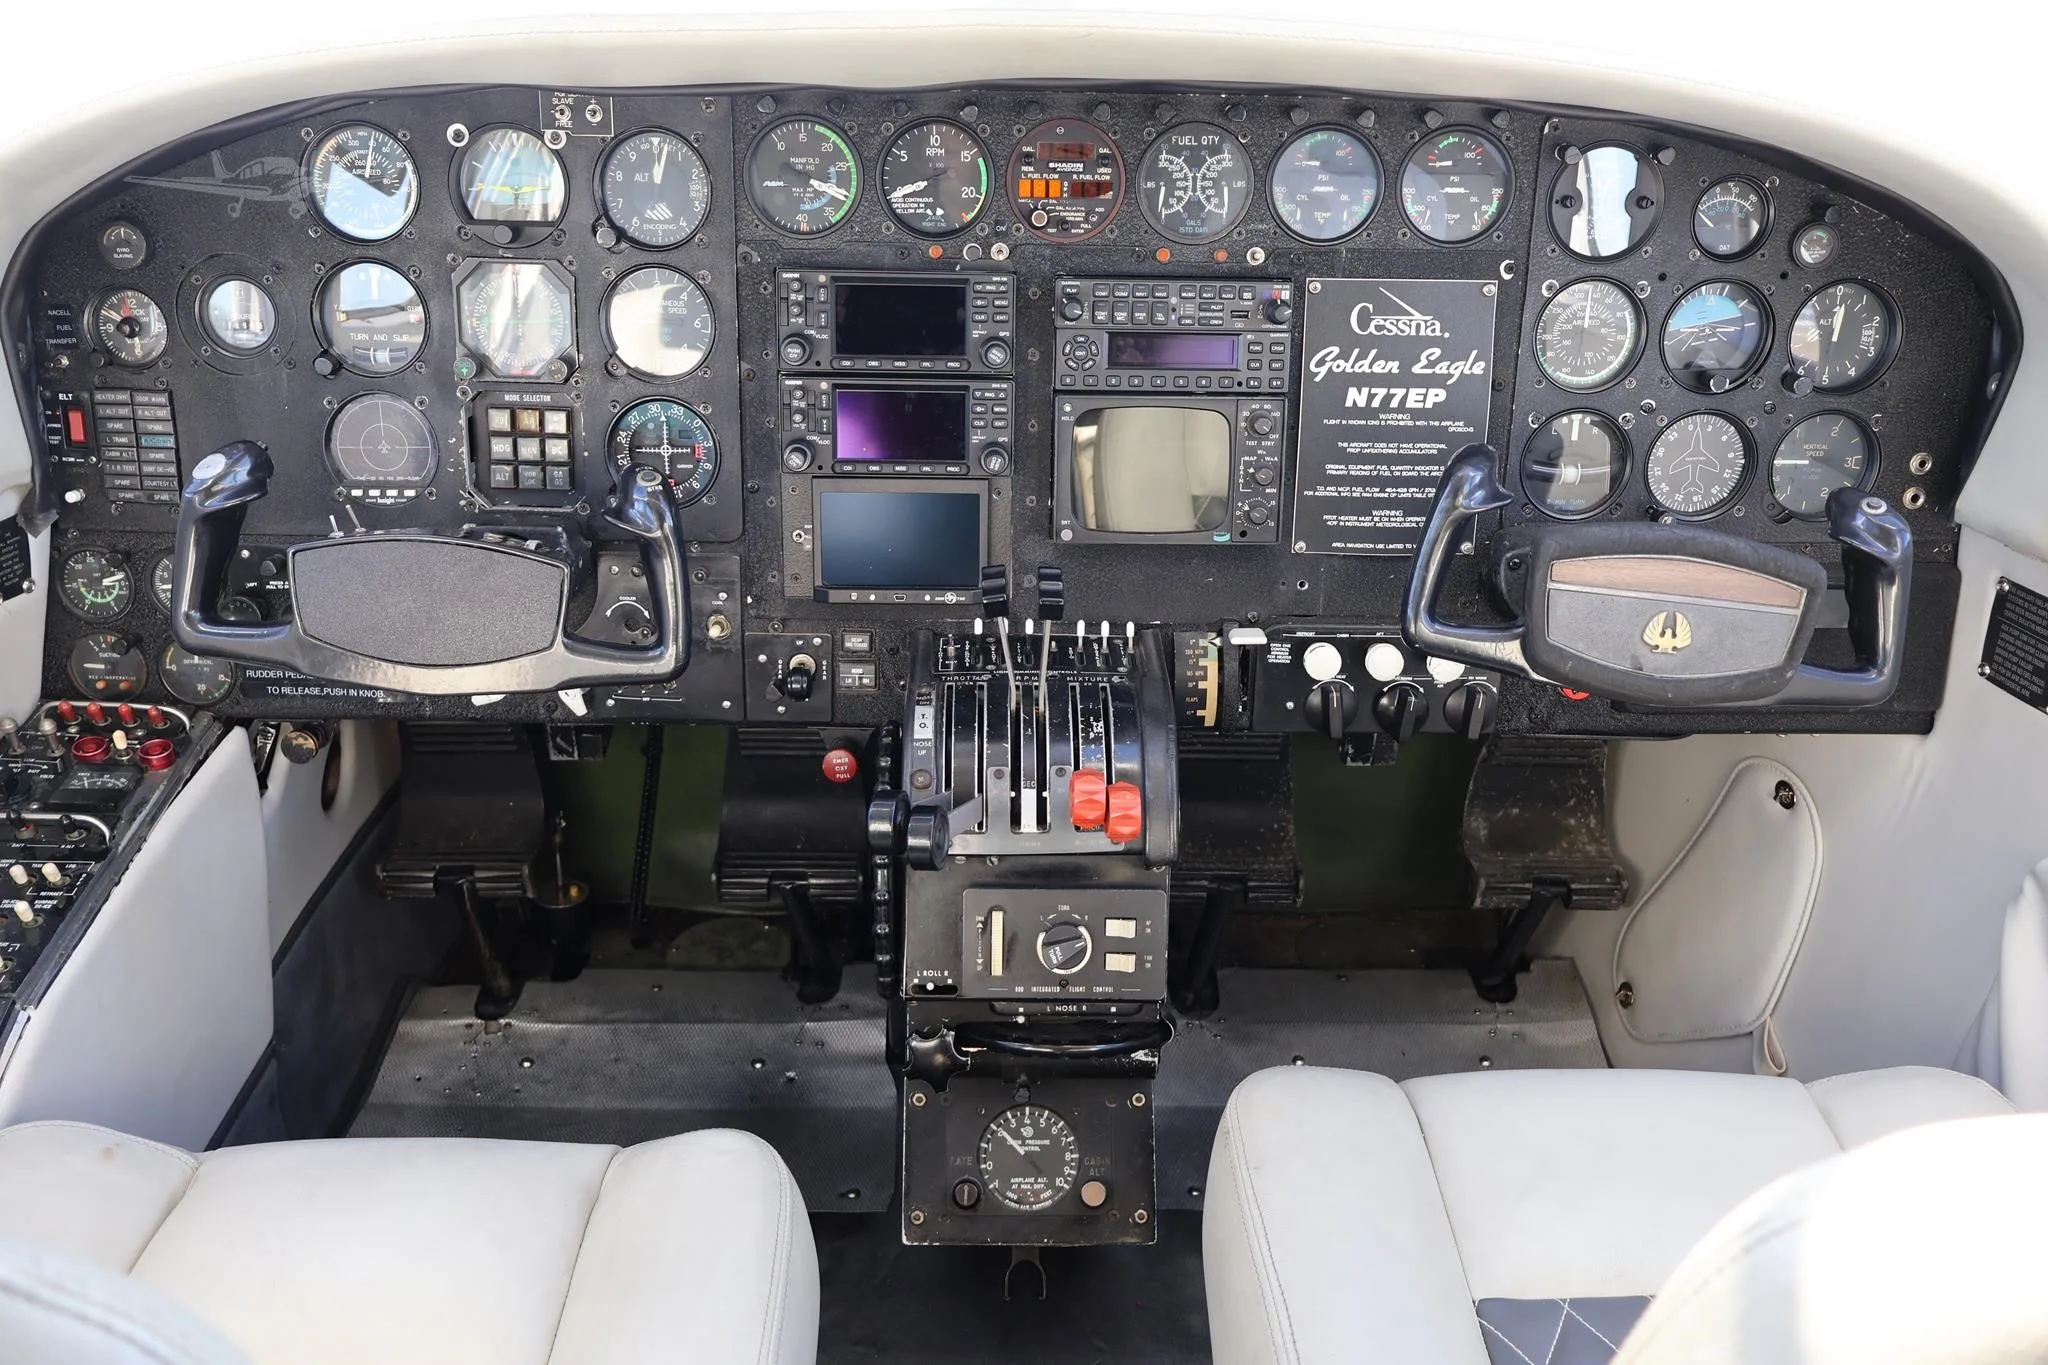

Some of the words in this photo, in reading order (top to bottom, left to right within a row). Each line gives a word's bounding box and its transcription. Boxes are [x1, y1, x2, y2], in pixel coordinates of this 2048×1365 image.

[551, 97, 574, 105] SLAVE
[555, 120, 573, 128] FREE
[799, 133, 808, 143] 15
[930, 134, 941, 146] 10
[1171, 135, 1198, 145] FUEL
[1201, 135, 1220, 145] QTY
[777, 141, 786, 151] 10
[821, 143, 834, 152] 20
[629, 151, 637, 162] 9
[900, 150, 908, 162] 5
[925, 147, 945, 157] RPM
[960, 150, 971, 162] 15
[835, 162, 847, 171] 25
[615, 170, 623, 182] 8
[634, 173, 649, 182] ALT
[1172, 171, 1185, 179] 200
[961, 186, 976, 198] 20
[823, 207, 835, 216] 35
[795, 214, 808, 222] 40
[1819, 318, 1832, 326] ALT
[45, 337, 77, 345] TRANSFER
[349, 332, 369, 341] TURN
[373, 333, 388, 341] AND
[392, 334, 410, 342] SLIP
[1309, 346, 1400, 382] Golden
[1411, 347, 1486, 386] Eagle
[58, 393, 73, 401] ELT
[504, 394, 521, 402] MODE
[522, 394, 552, 402] SELECTOR
[1344, 386, 1447, 409] N77EP
[647, 403, 661, 414] 30
[670, 404, 684, 416] 33
[628, 411, 640, 425] 27
[616, 430, 628, 444] 24
[492, 444, 511, 453] HDG
[551, 447, 562, 455] BC
[616, 453, 628, 466] 21
[495, 473, 509, 481] ALT
[1371, 509, 1404, 517] WARNING
[245, 669, 284, 679] RUDDER
[266, 686, 280, 695] TO
[348, 688, 358, 697] IN
[359, 689, 386, 698] KNOB.
[1055, 1177, 1065, 1187] 10
